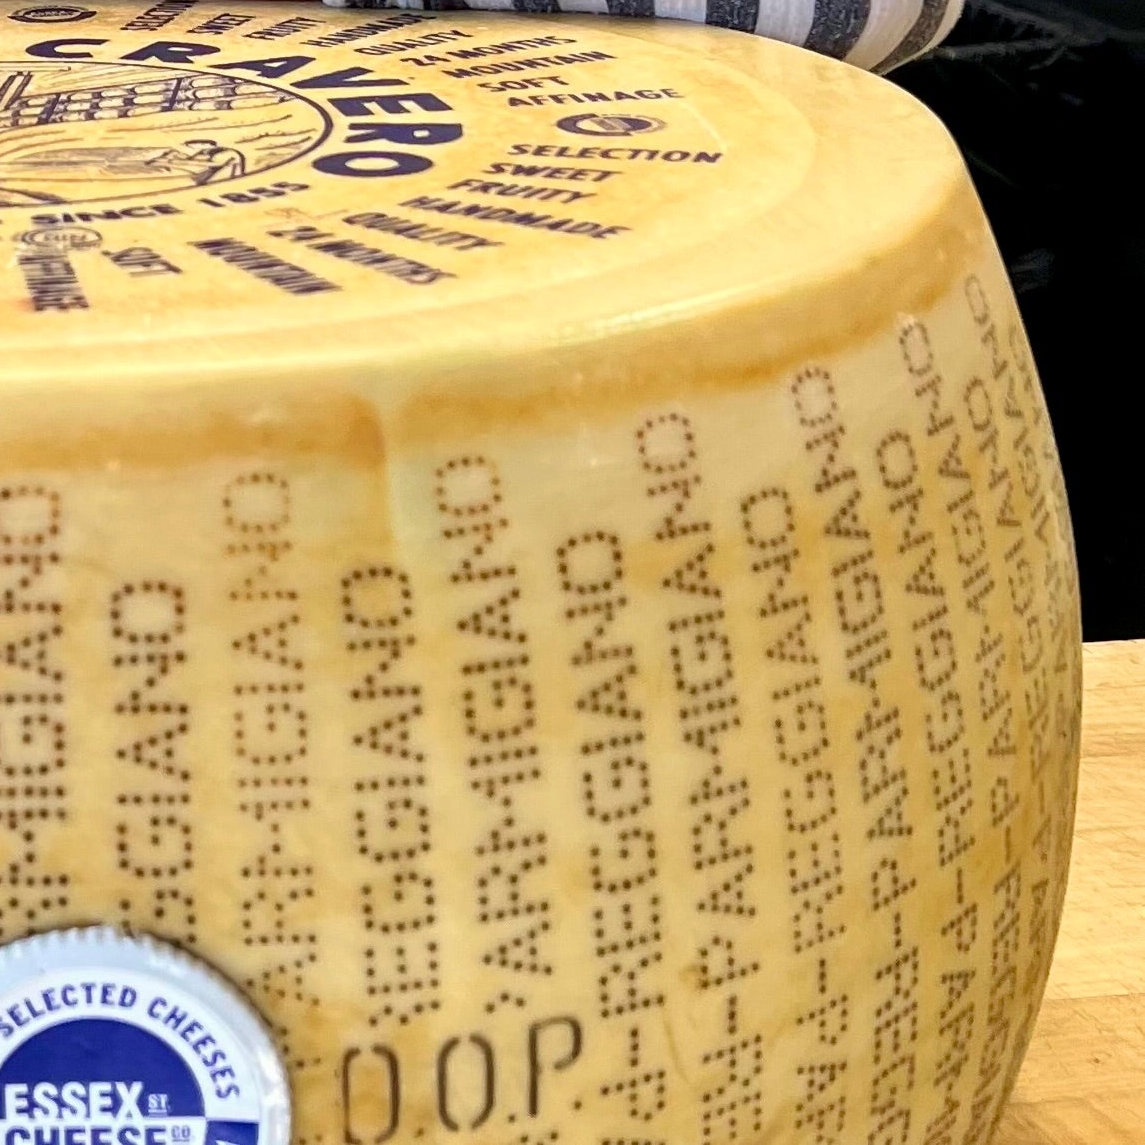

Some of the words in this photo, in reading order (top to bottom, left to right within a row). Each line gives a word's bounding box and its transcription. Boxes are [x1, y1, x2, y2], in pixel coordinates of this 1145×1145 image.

[354, 29, 475, 56] QUALITY
[400, 52, 451, 67] 24
[449, 35, 579, 60] MONTHS
[441, 50, 617, 80] MOUNTAIN
[476, 75, 569, 94] SOFT
[505, 87, 688, 109] AFFINAGE
[25, 38, 464, 178] CRAVERO
[505, 142, 725, 164] SELECTION
[482, 161, 625, 183] SWEET
[31, 203, 184, 226] SINCE
[196, 180, 312, 209] 1855
[446, 178, 600, 204] FRUITY
[397, 195, 635, 240] HANDMADE
[146, 995, 241, 1101] CHEESES
[3, 1081, 145, 1122] ESSEX
